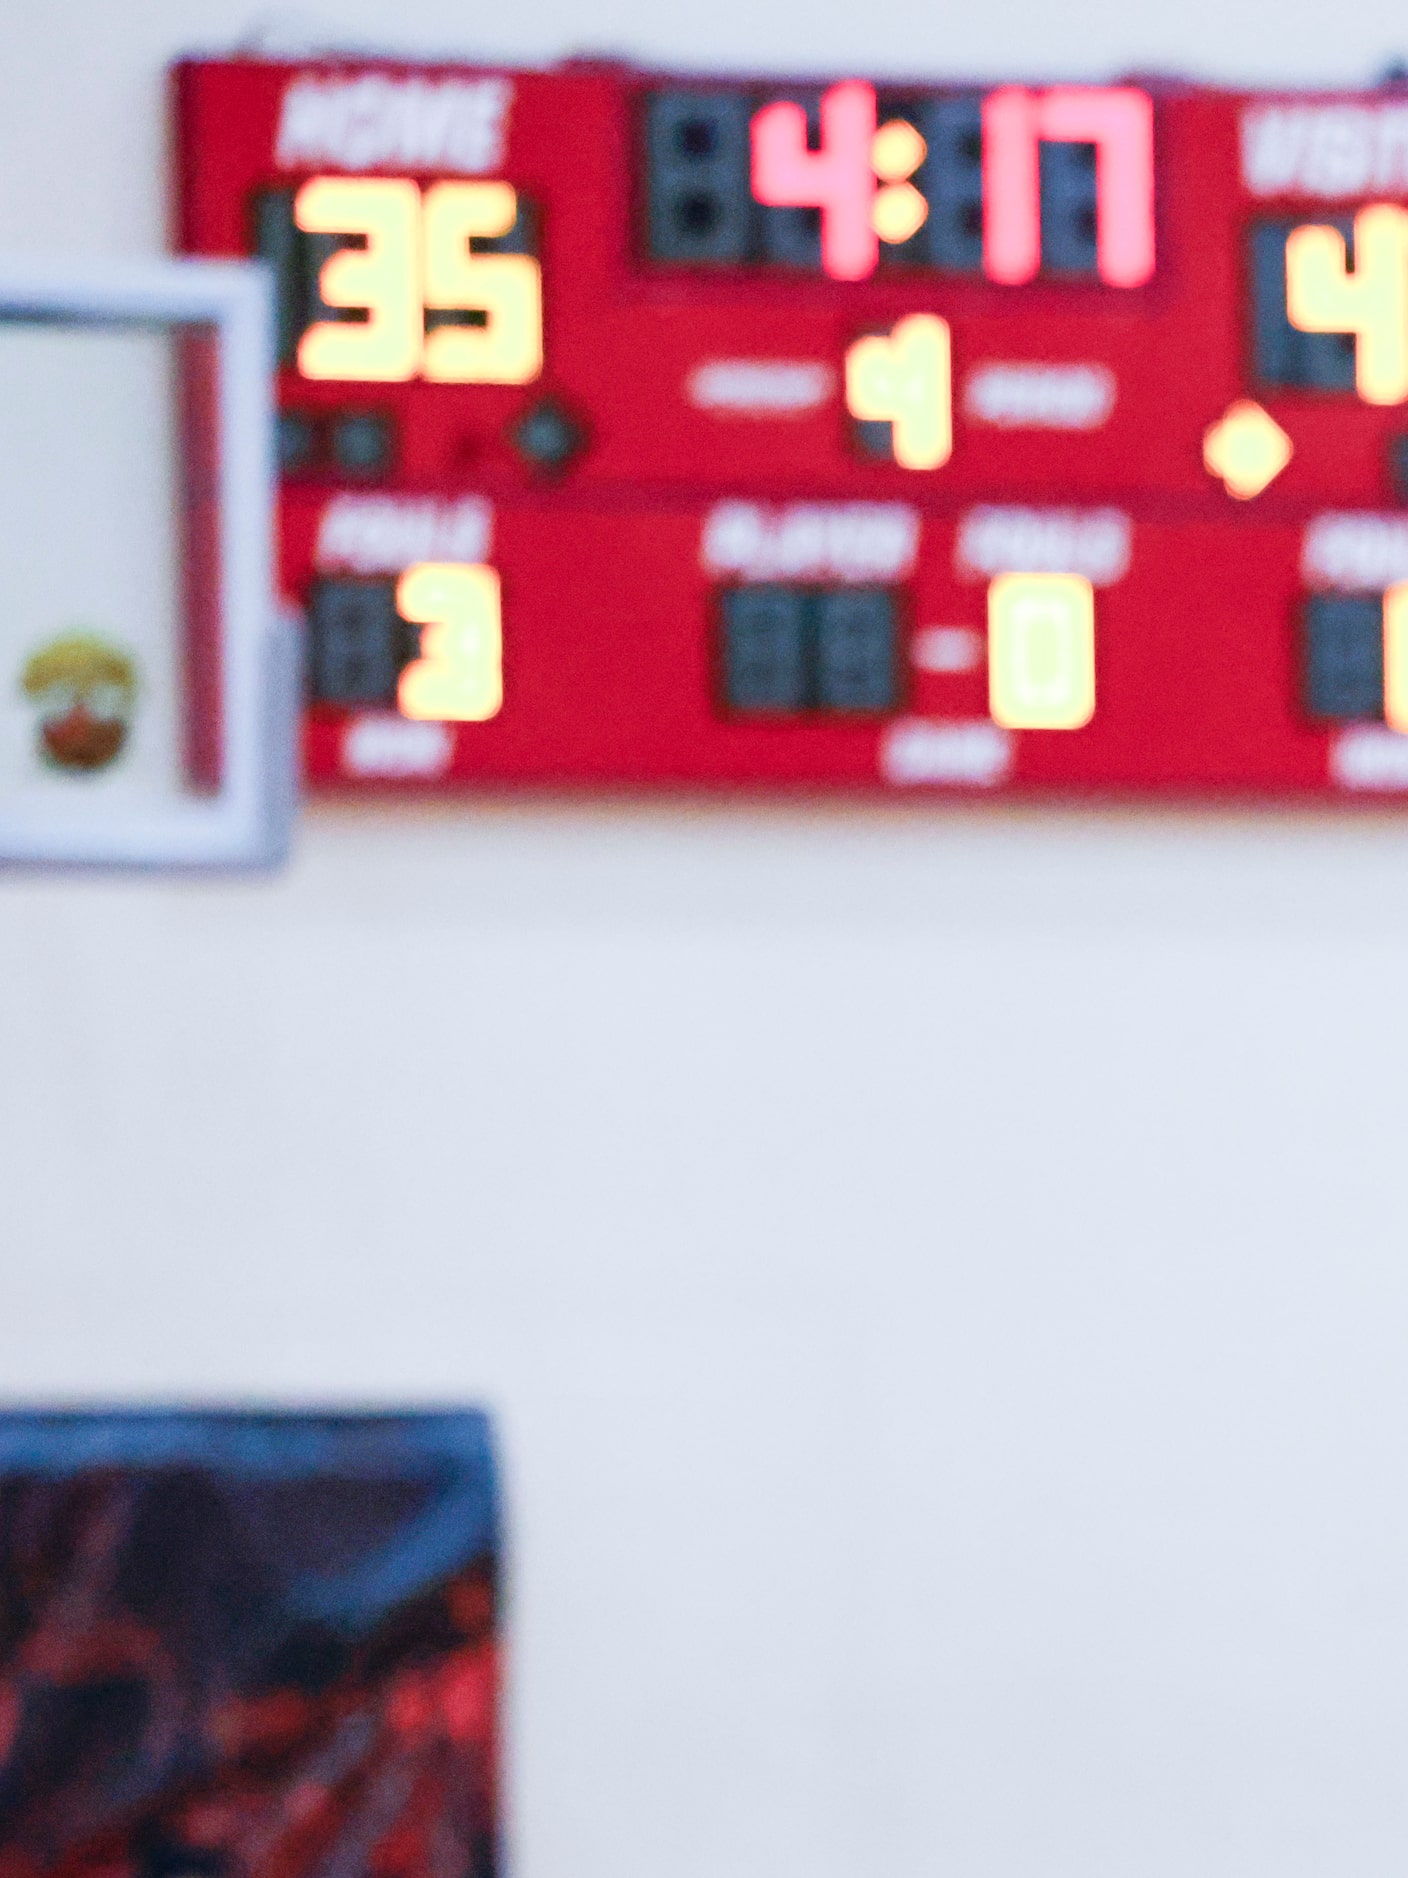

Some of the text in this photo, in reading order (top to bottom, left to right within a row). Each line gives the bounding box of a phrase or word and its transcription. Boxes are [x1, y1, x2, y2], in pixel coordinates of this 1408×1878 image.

[749, 78, 1156, 289] 4:17
[295, 175, 543, 386] 35
[845, 313, 952, 470] 4
[396, 562, 503, 721] 3
